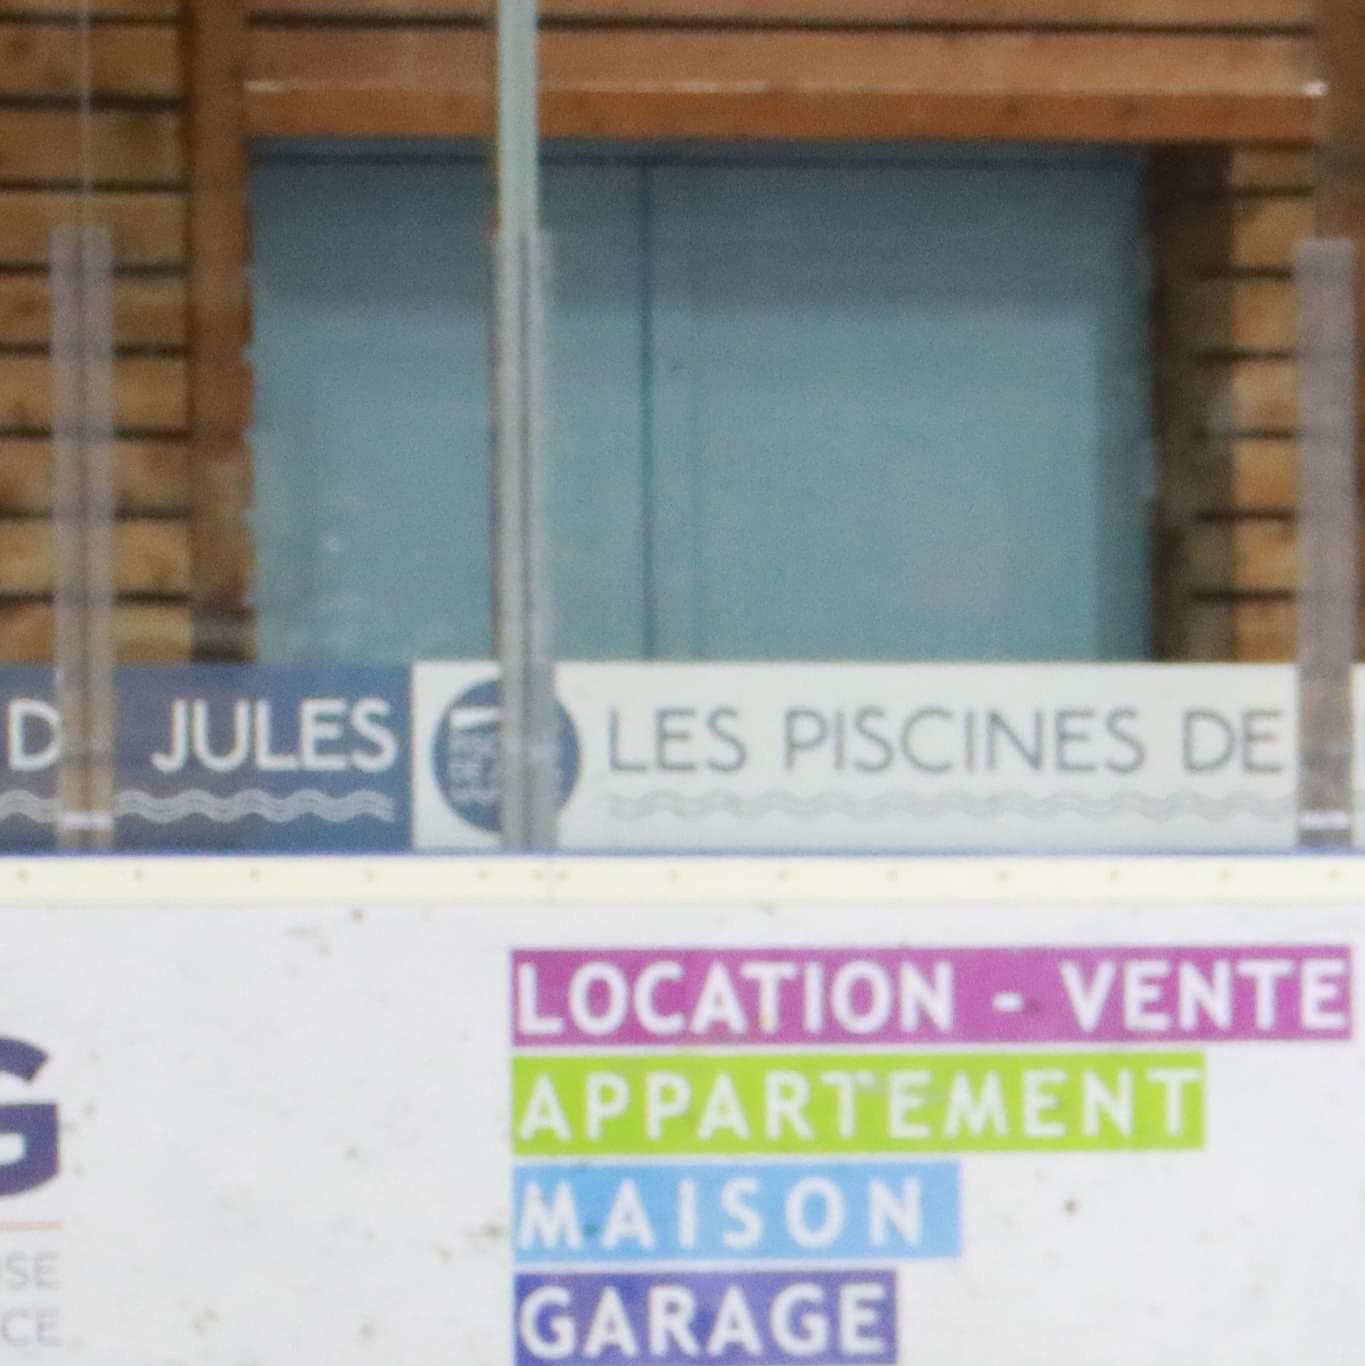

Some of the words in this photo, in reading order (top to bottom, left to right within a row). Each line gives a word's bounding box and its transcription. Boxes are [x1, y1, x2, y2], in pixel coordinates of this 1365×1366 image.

[8, 699, 58, 771] D
[152, 698, 396, 773] JULES
[608, 706, 747, 774] LES
[784, 705, 1145, 774] PISCINES
[1182, 706, 1285, 773] DE
[514, 960, 955, 1037] LOCATION
[1059, 957, 1348, 1034] VENTE
[518, 1068, 1200, 1143] APPARTEMENT
[516, 1176, 924, 1252] MAISON
[518, 1281, 888, 1361] GARAGE
